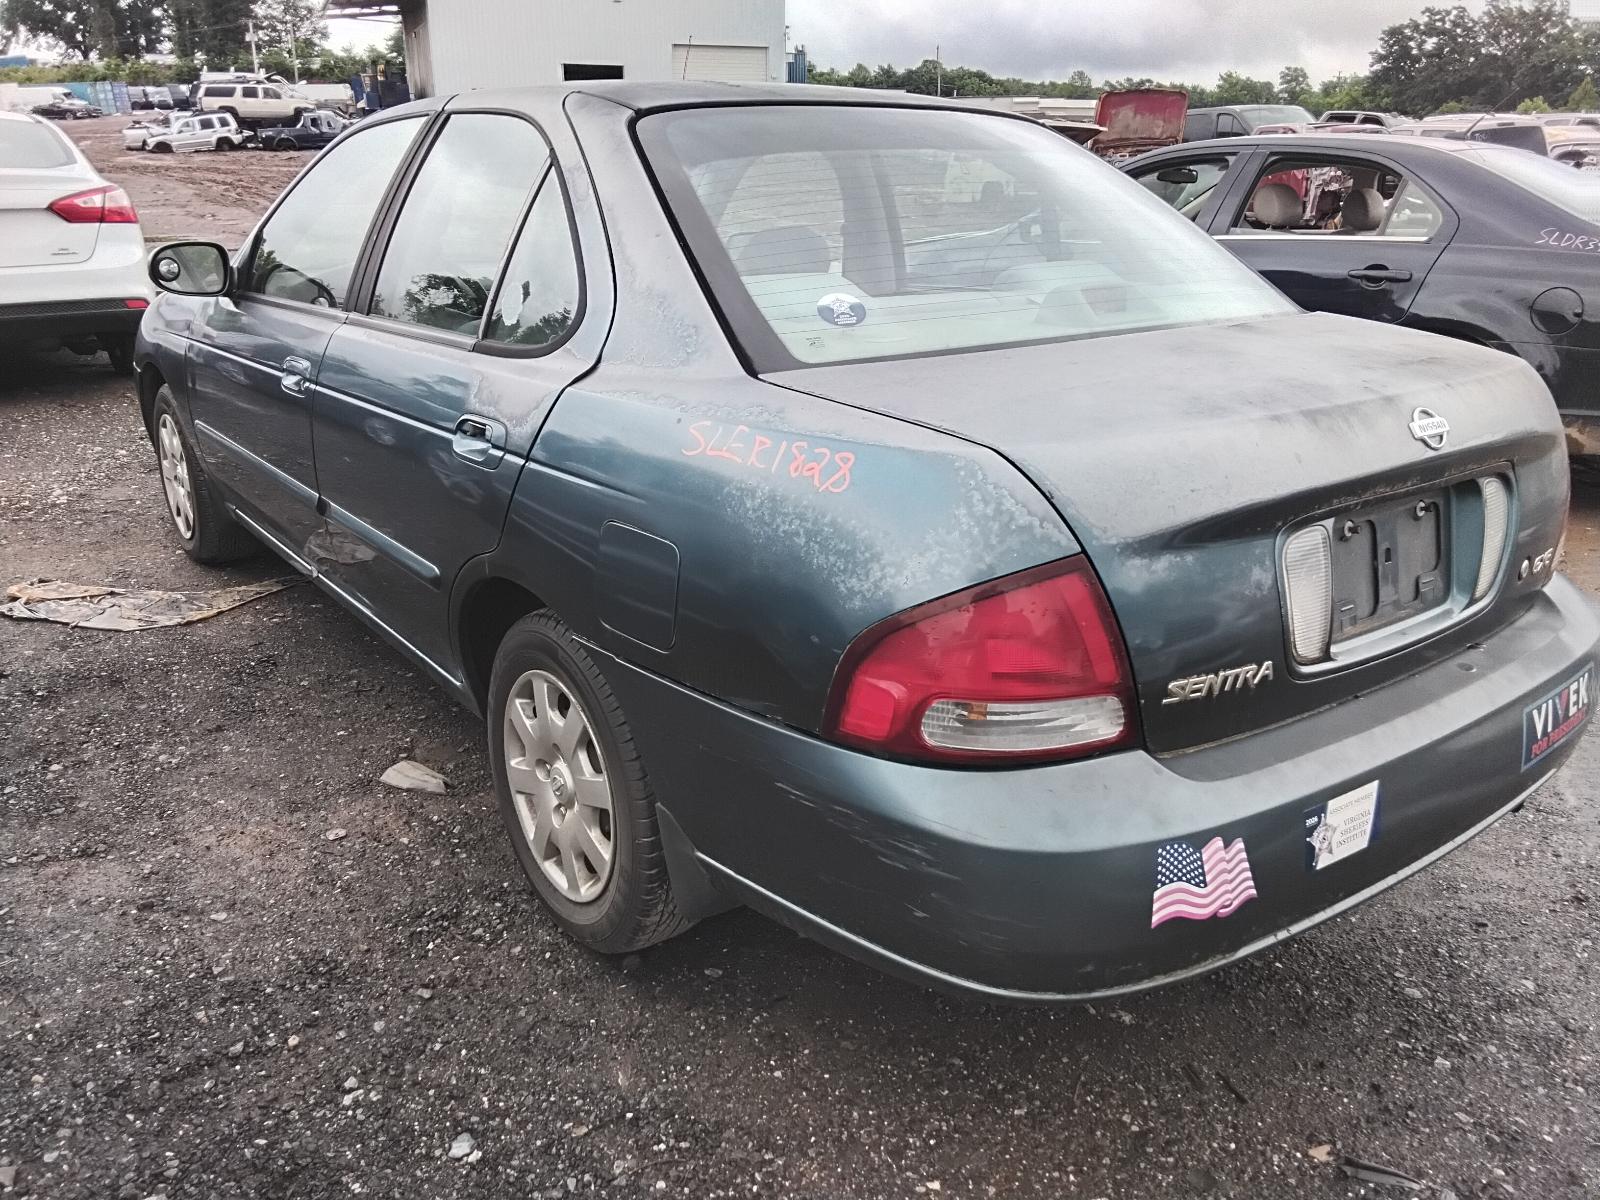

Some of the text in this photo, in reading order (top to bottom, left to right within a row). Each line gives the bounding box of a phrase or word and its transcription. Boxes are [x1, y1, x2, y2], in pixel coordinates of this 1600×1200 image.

[1417, 418, 1448, 434] NISSAN
[1161, 660, 1274, 705] SENTRA
[1532, 672, 1588, 739] VIVEK
[1343, 809, 1371, 826] VIRGINIA
[1336, 829, 1367, 848] INSTITUTE
